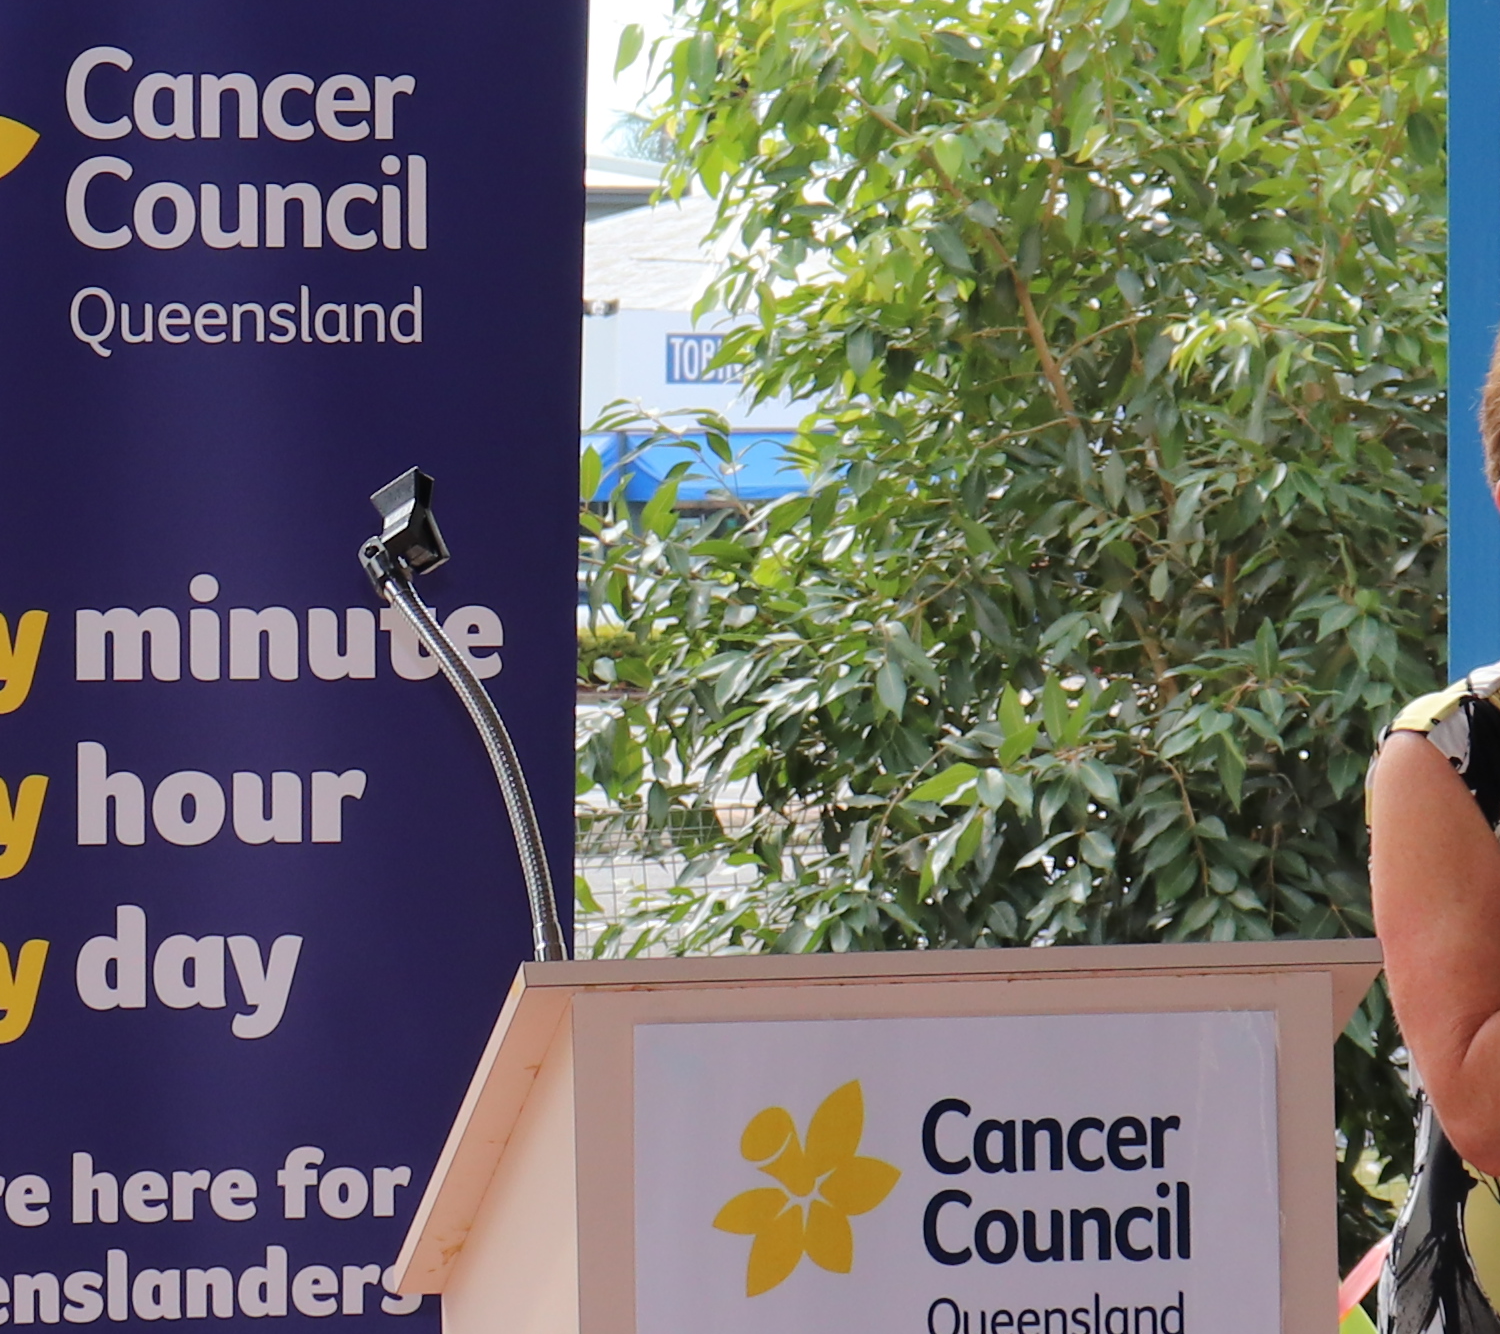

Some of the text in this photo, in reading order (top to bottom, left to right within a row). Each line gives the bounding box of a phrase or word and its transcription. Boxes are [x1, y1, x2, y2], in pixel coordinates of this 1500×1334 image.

[65, 46, 416, 142] Cancer
[65, 154, 428, 250] Council
[70, 284, 424, 358] Queensland
[75, 573, 504, 682] minute
[77, 741, 367, 846] hour
[76, 904, 304, 1039] day
[921, 1098, 1181, 1175] Cancer
[72, 1151, 258, 1224] here
[276, 1146, 411, 1220] for
[922, 1181, 1191, 1266] Council
